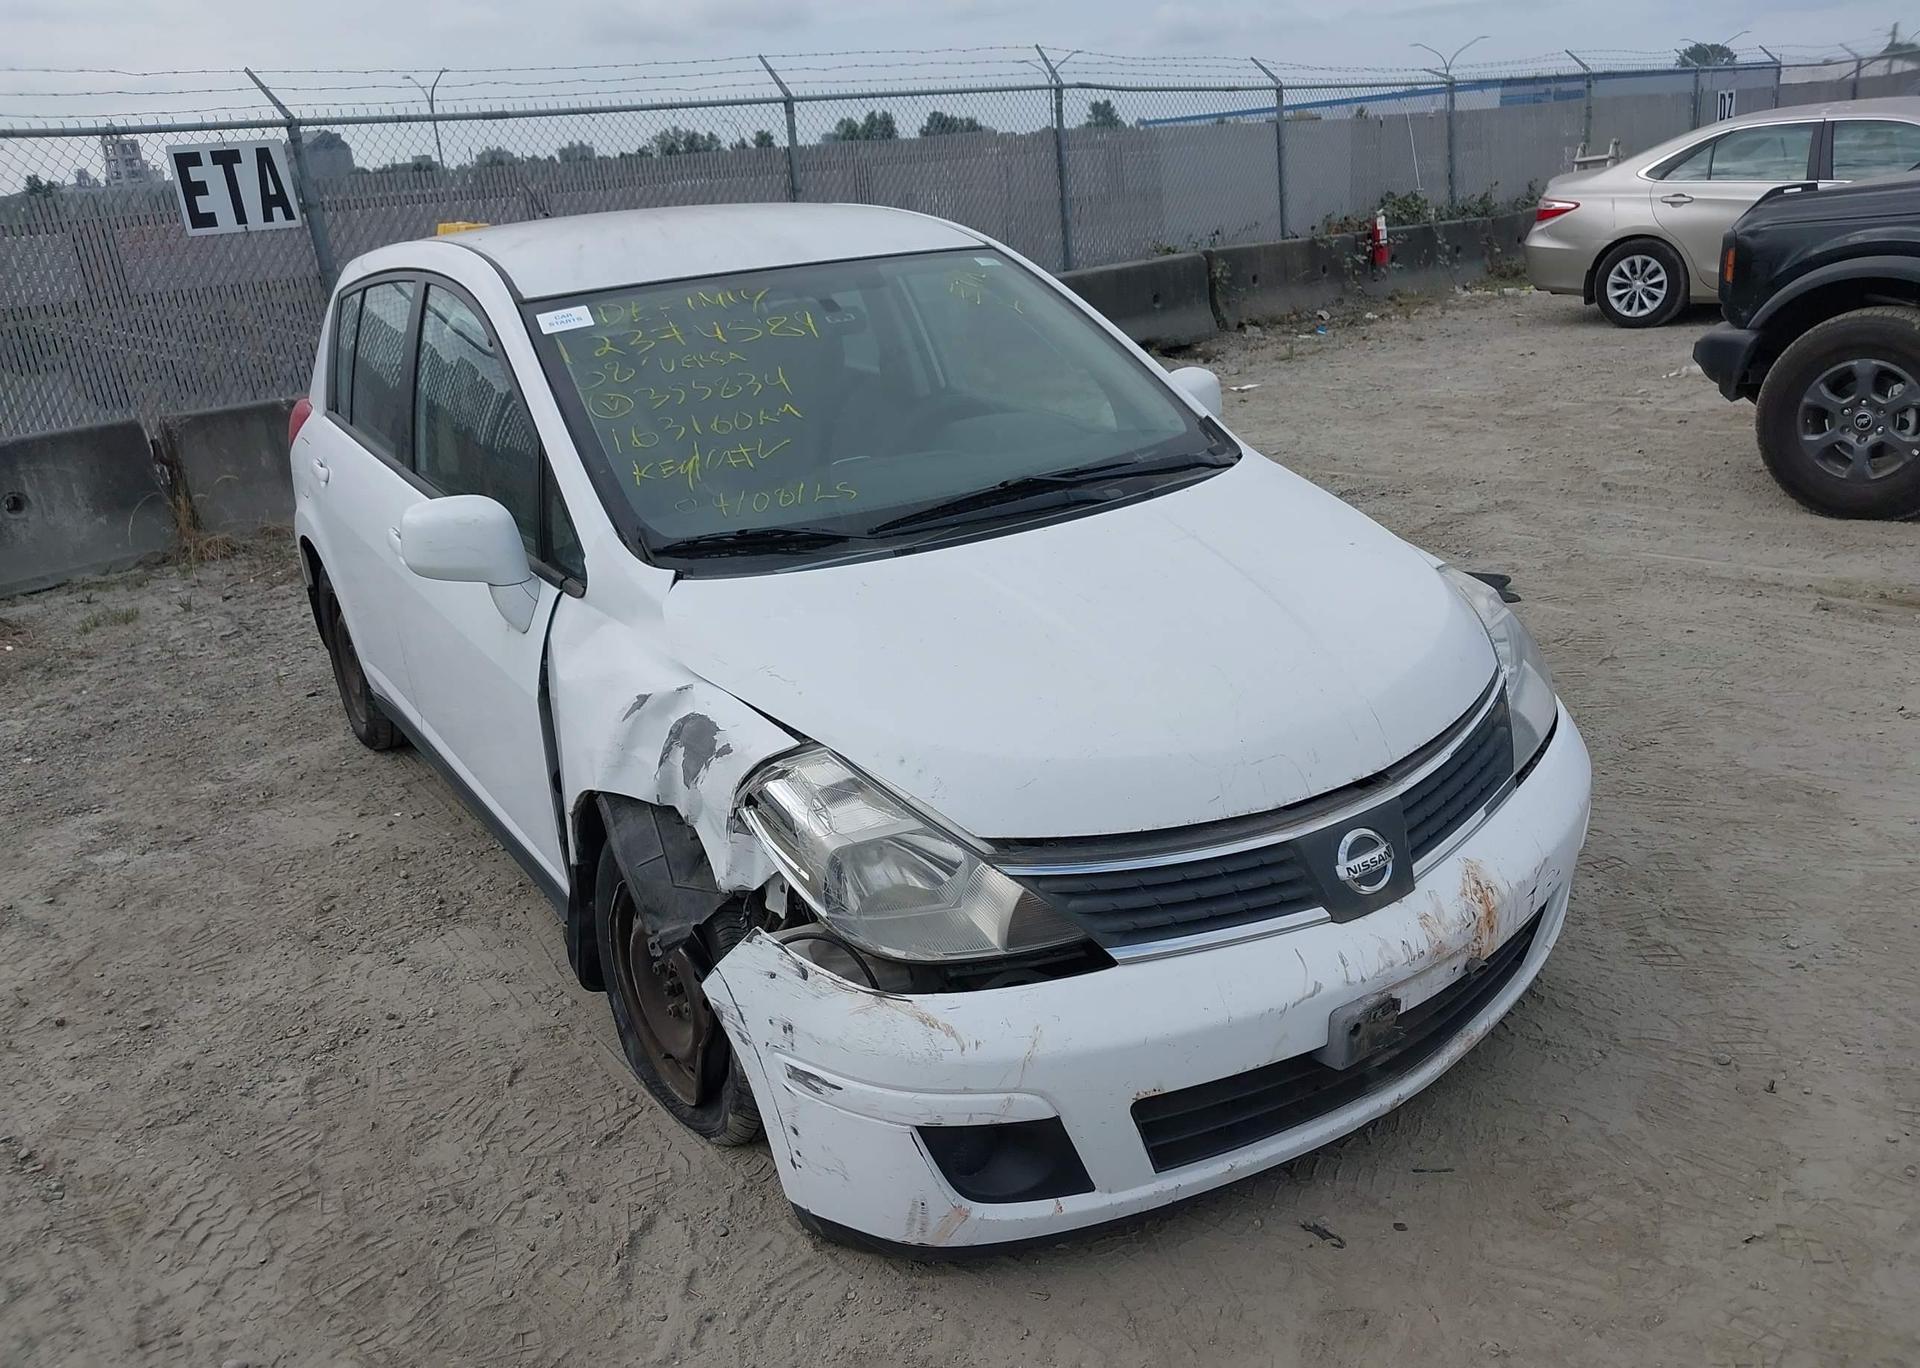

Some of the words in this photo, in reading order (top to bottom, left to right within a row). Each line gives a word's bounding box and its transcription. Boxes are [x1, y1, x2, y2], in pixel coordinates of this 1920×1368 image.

[1719, 92, 1734, 121] DZ
[173, 147, 296, 229] ETA
[548, 317, 583, 327] STARTS
[554, 312, 574, 321] CAR
[1345, 844, 1392, 876] NISSAN
